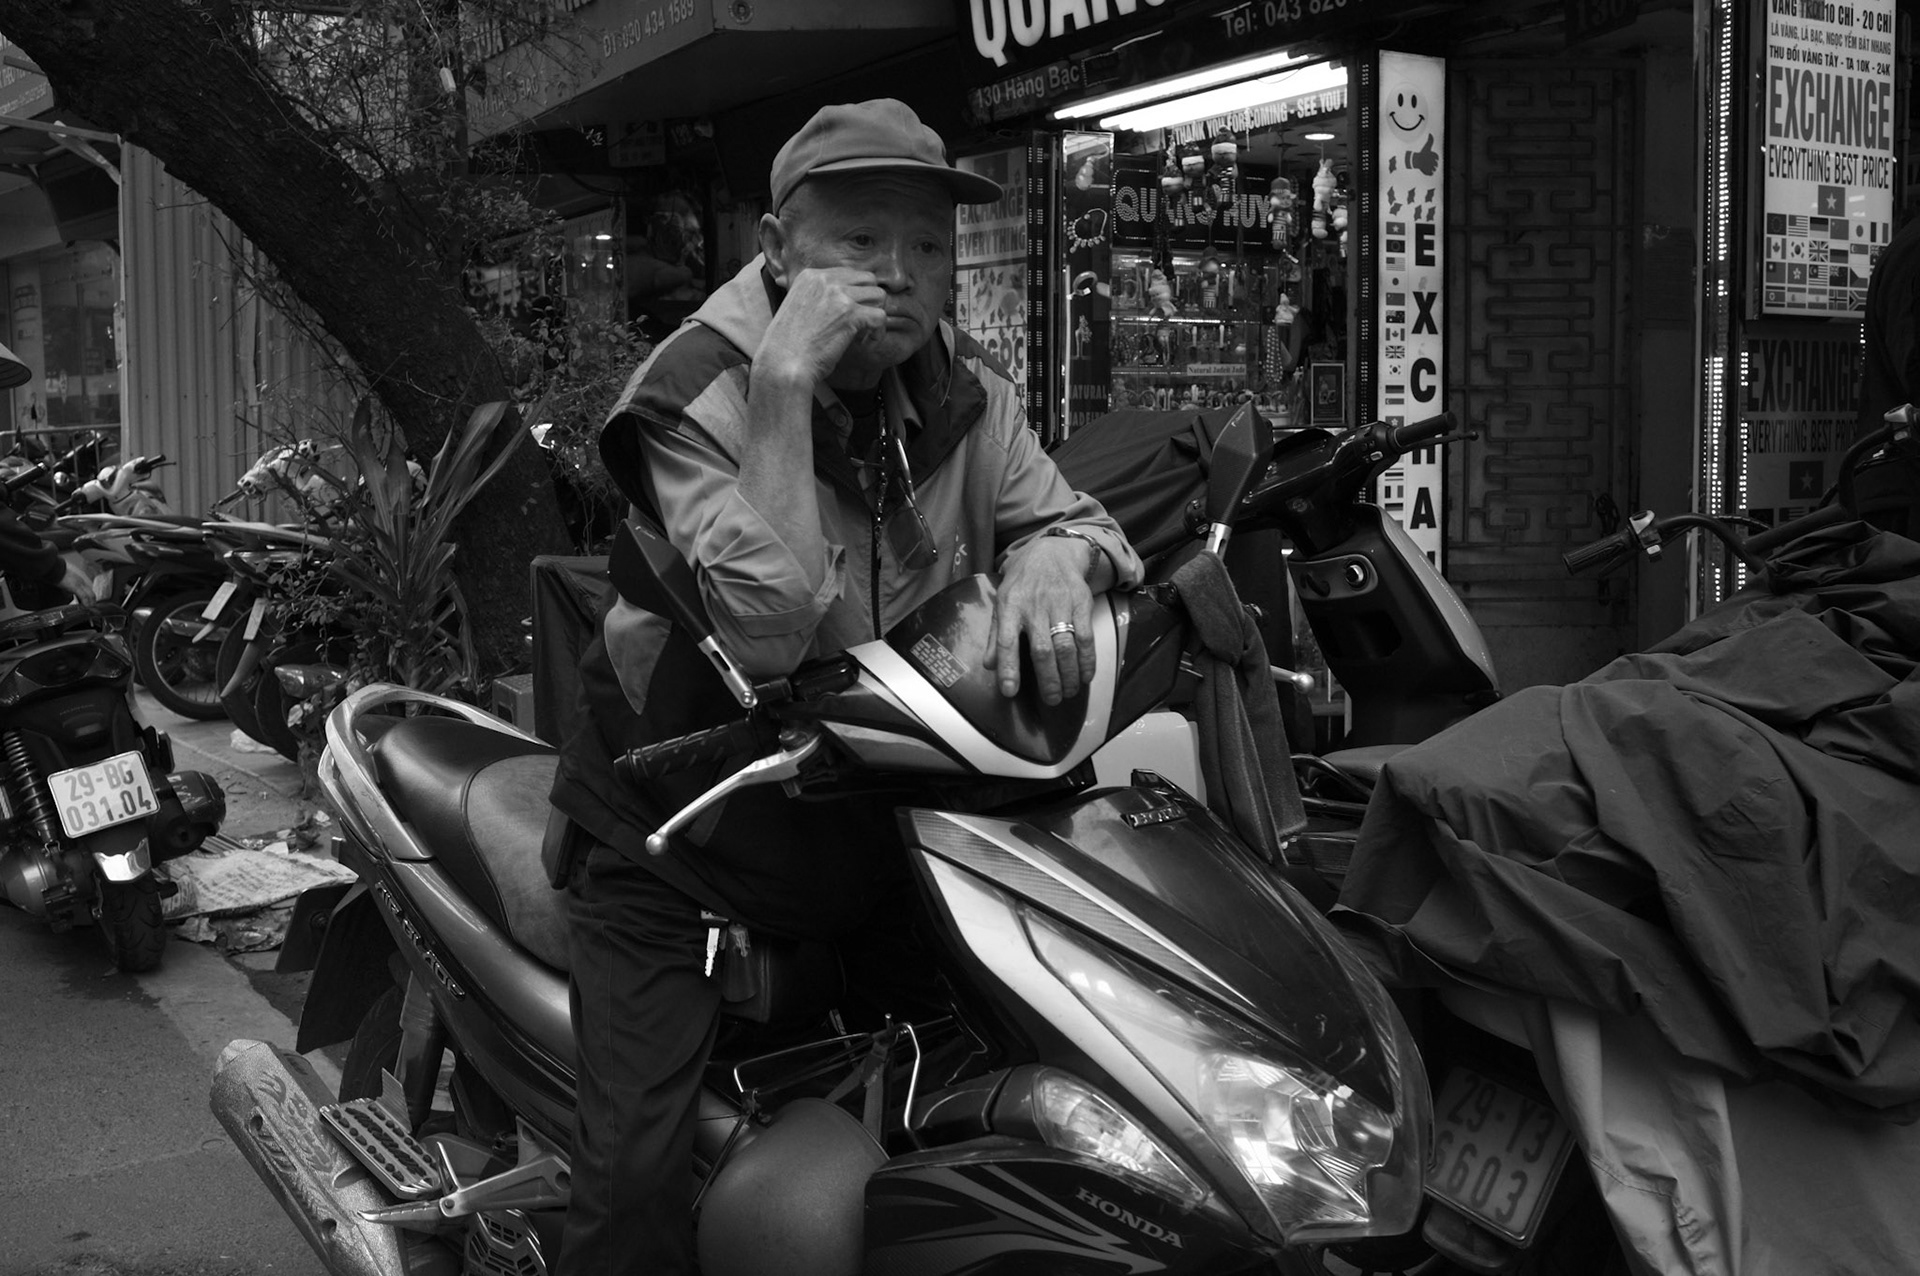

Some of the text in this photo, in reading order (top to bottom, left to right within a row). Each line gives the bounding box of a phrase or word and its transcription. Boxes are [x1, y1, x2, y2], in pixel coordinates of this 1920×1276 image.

[644, 7, 666, 37] 434
[668, 0, 695, 26] 1589
[969, 0, 1166, 67] QUA
[1221, 9, 1258, 39] Tel:
[1265, 0, 1302, 27] 043
[1825, 3, 1835, 24] 10
[1862, 10, 1874, 31] 20
[1770, 45, 1785, 59] THU
[1857, 59, 1870, 73] 10K
[1876, 62, 1891, 77] 24K
[976, 64, 1081, 107] 130 Hàng Bạc
[1175, 120, 1206, 146] THANK
[1227, 110, 1246, 134] FOR
[1249, 101, 1288, 128] COMING
[1297, 97, 1318, 119] SEE
[1320, 90, 1341, 113] YOU
[1769, 65, 1890, 151] EXCHANGE
[1769, 144, 1889, 189] EVERYTHING BEST PRICE
[958, 225, 1025, 258] EVERYTHING
[1069, 384, 1107, 400] ATURAL
[1410, 223, 1438, 566] EXCA
[1747, 338, 1859, 413] EXCHANGE
[1811, 420, 1833, 453] BEST
[1835, 419, 1859, 452] PRIC
[66, 786, 152, 832] 031.04
[1076, 1186, 1183, 1249] HONDA
